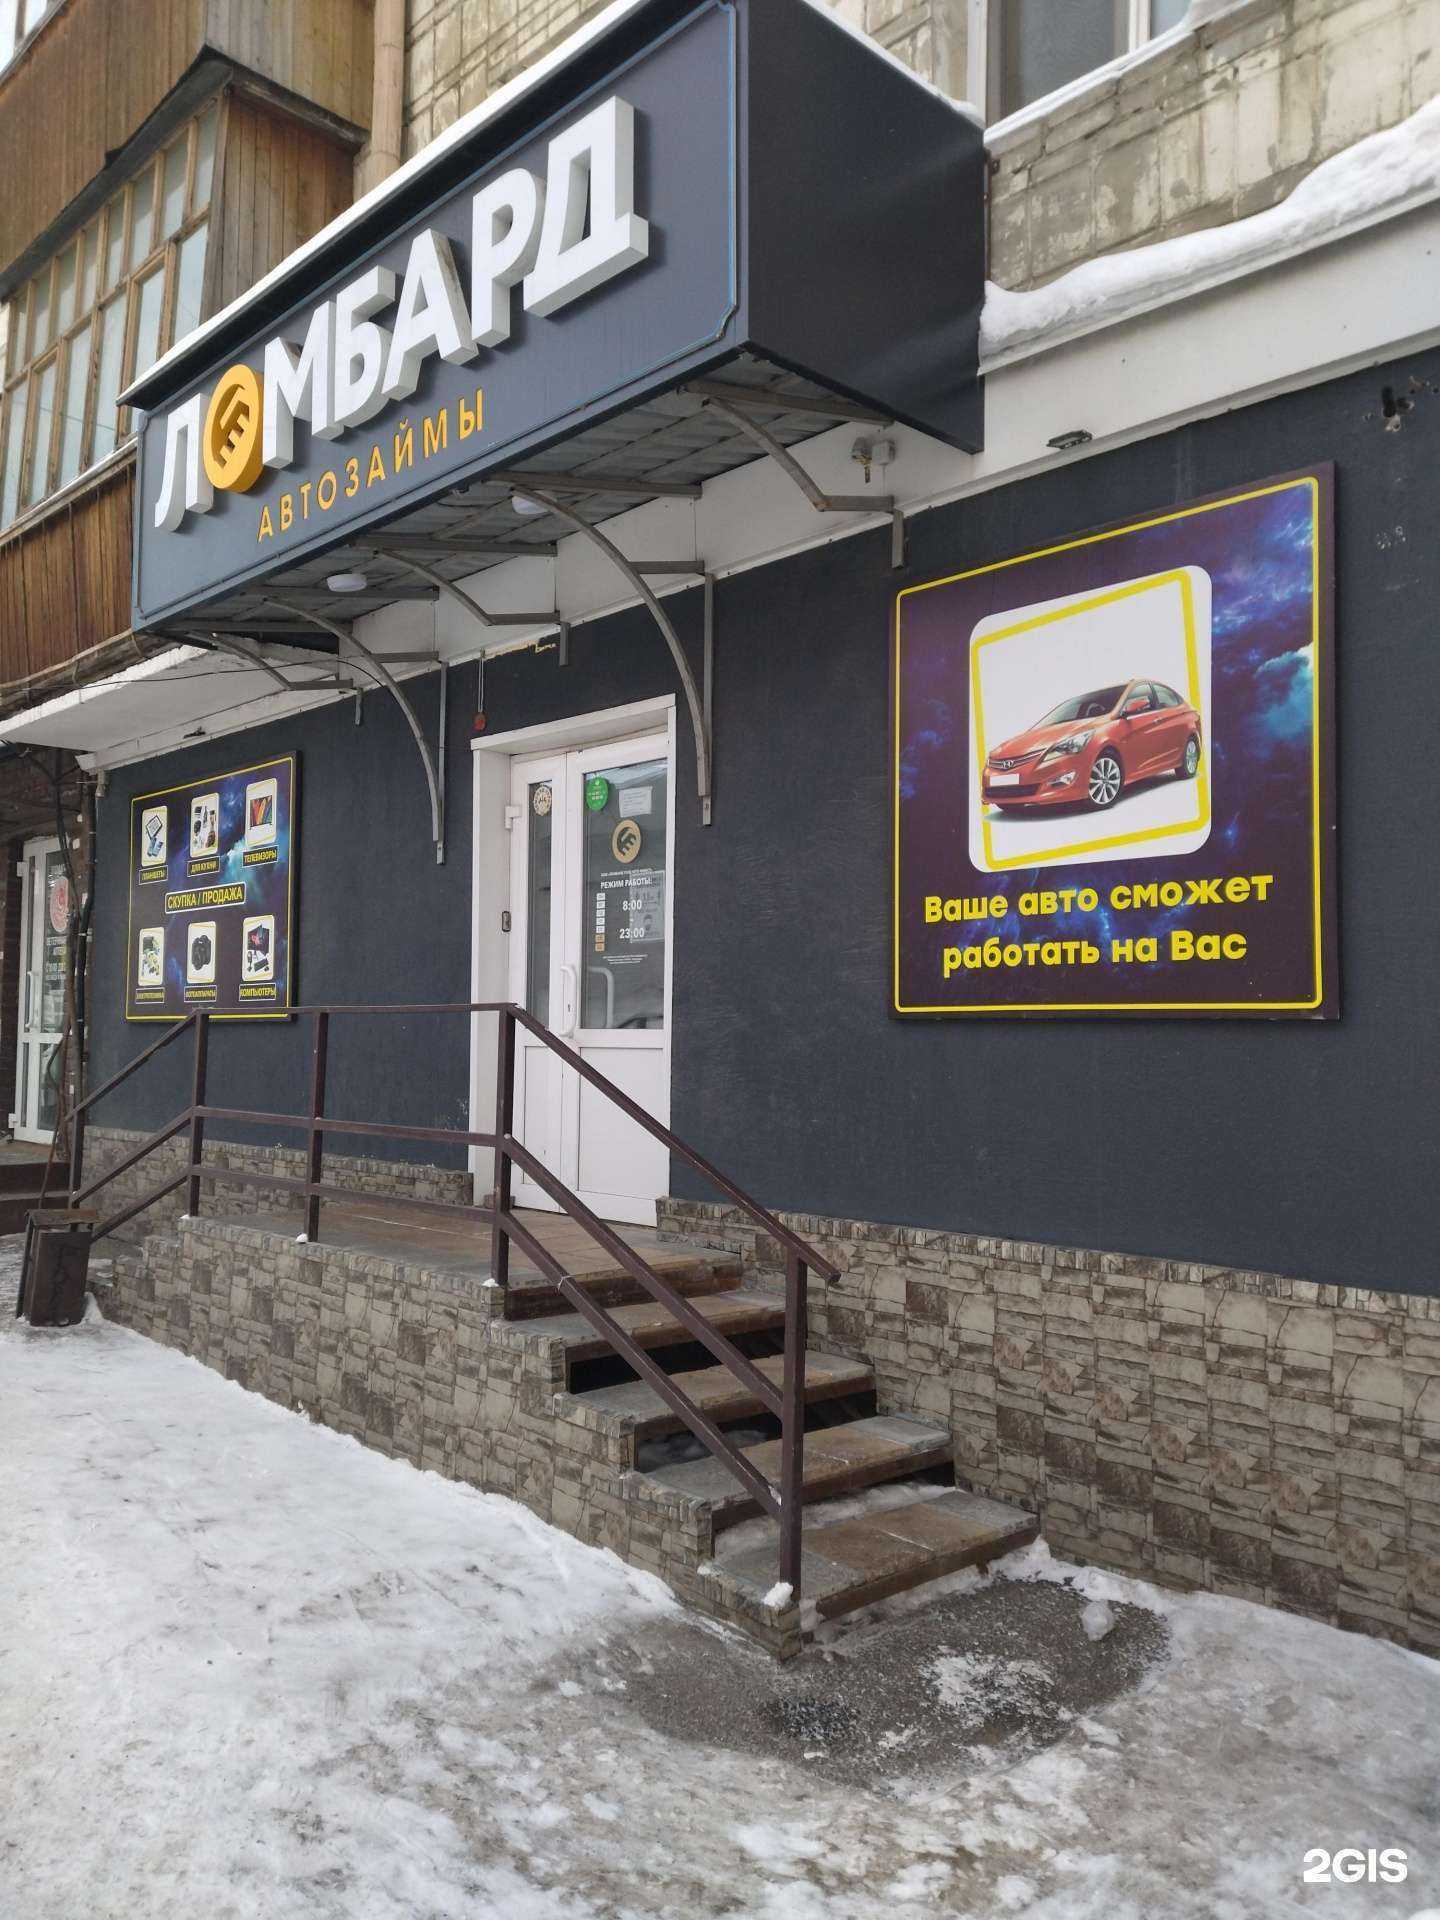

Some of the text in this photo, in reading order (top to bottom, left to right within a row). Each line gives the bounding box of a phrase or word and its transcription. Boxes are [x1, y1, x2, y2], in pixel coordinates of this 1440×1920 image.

[155, 96, 649, 533] ЛОМБАРД
[257, 388, 485, 543] АВТОЗАЙМЫ
[244, 849, 277, 864] ТЕЛЕВИЗОРЫ
[601, 880, 623, 889] РЕЖИМ
[167, 892, 197, 909] СКУПКА
[202, 886, 243, 905] ПРОДАЖА
[622, 900, 642, 911] 8:00
[924, 873, 1274, 924] Ваше авто сможет
[619, 928, 645, 939] 23:00
[942, 929, 1248, 978] работать на Вас
